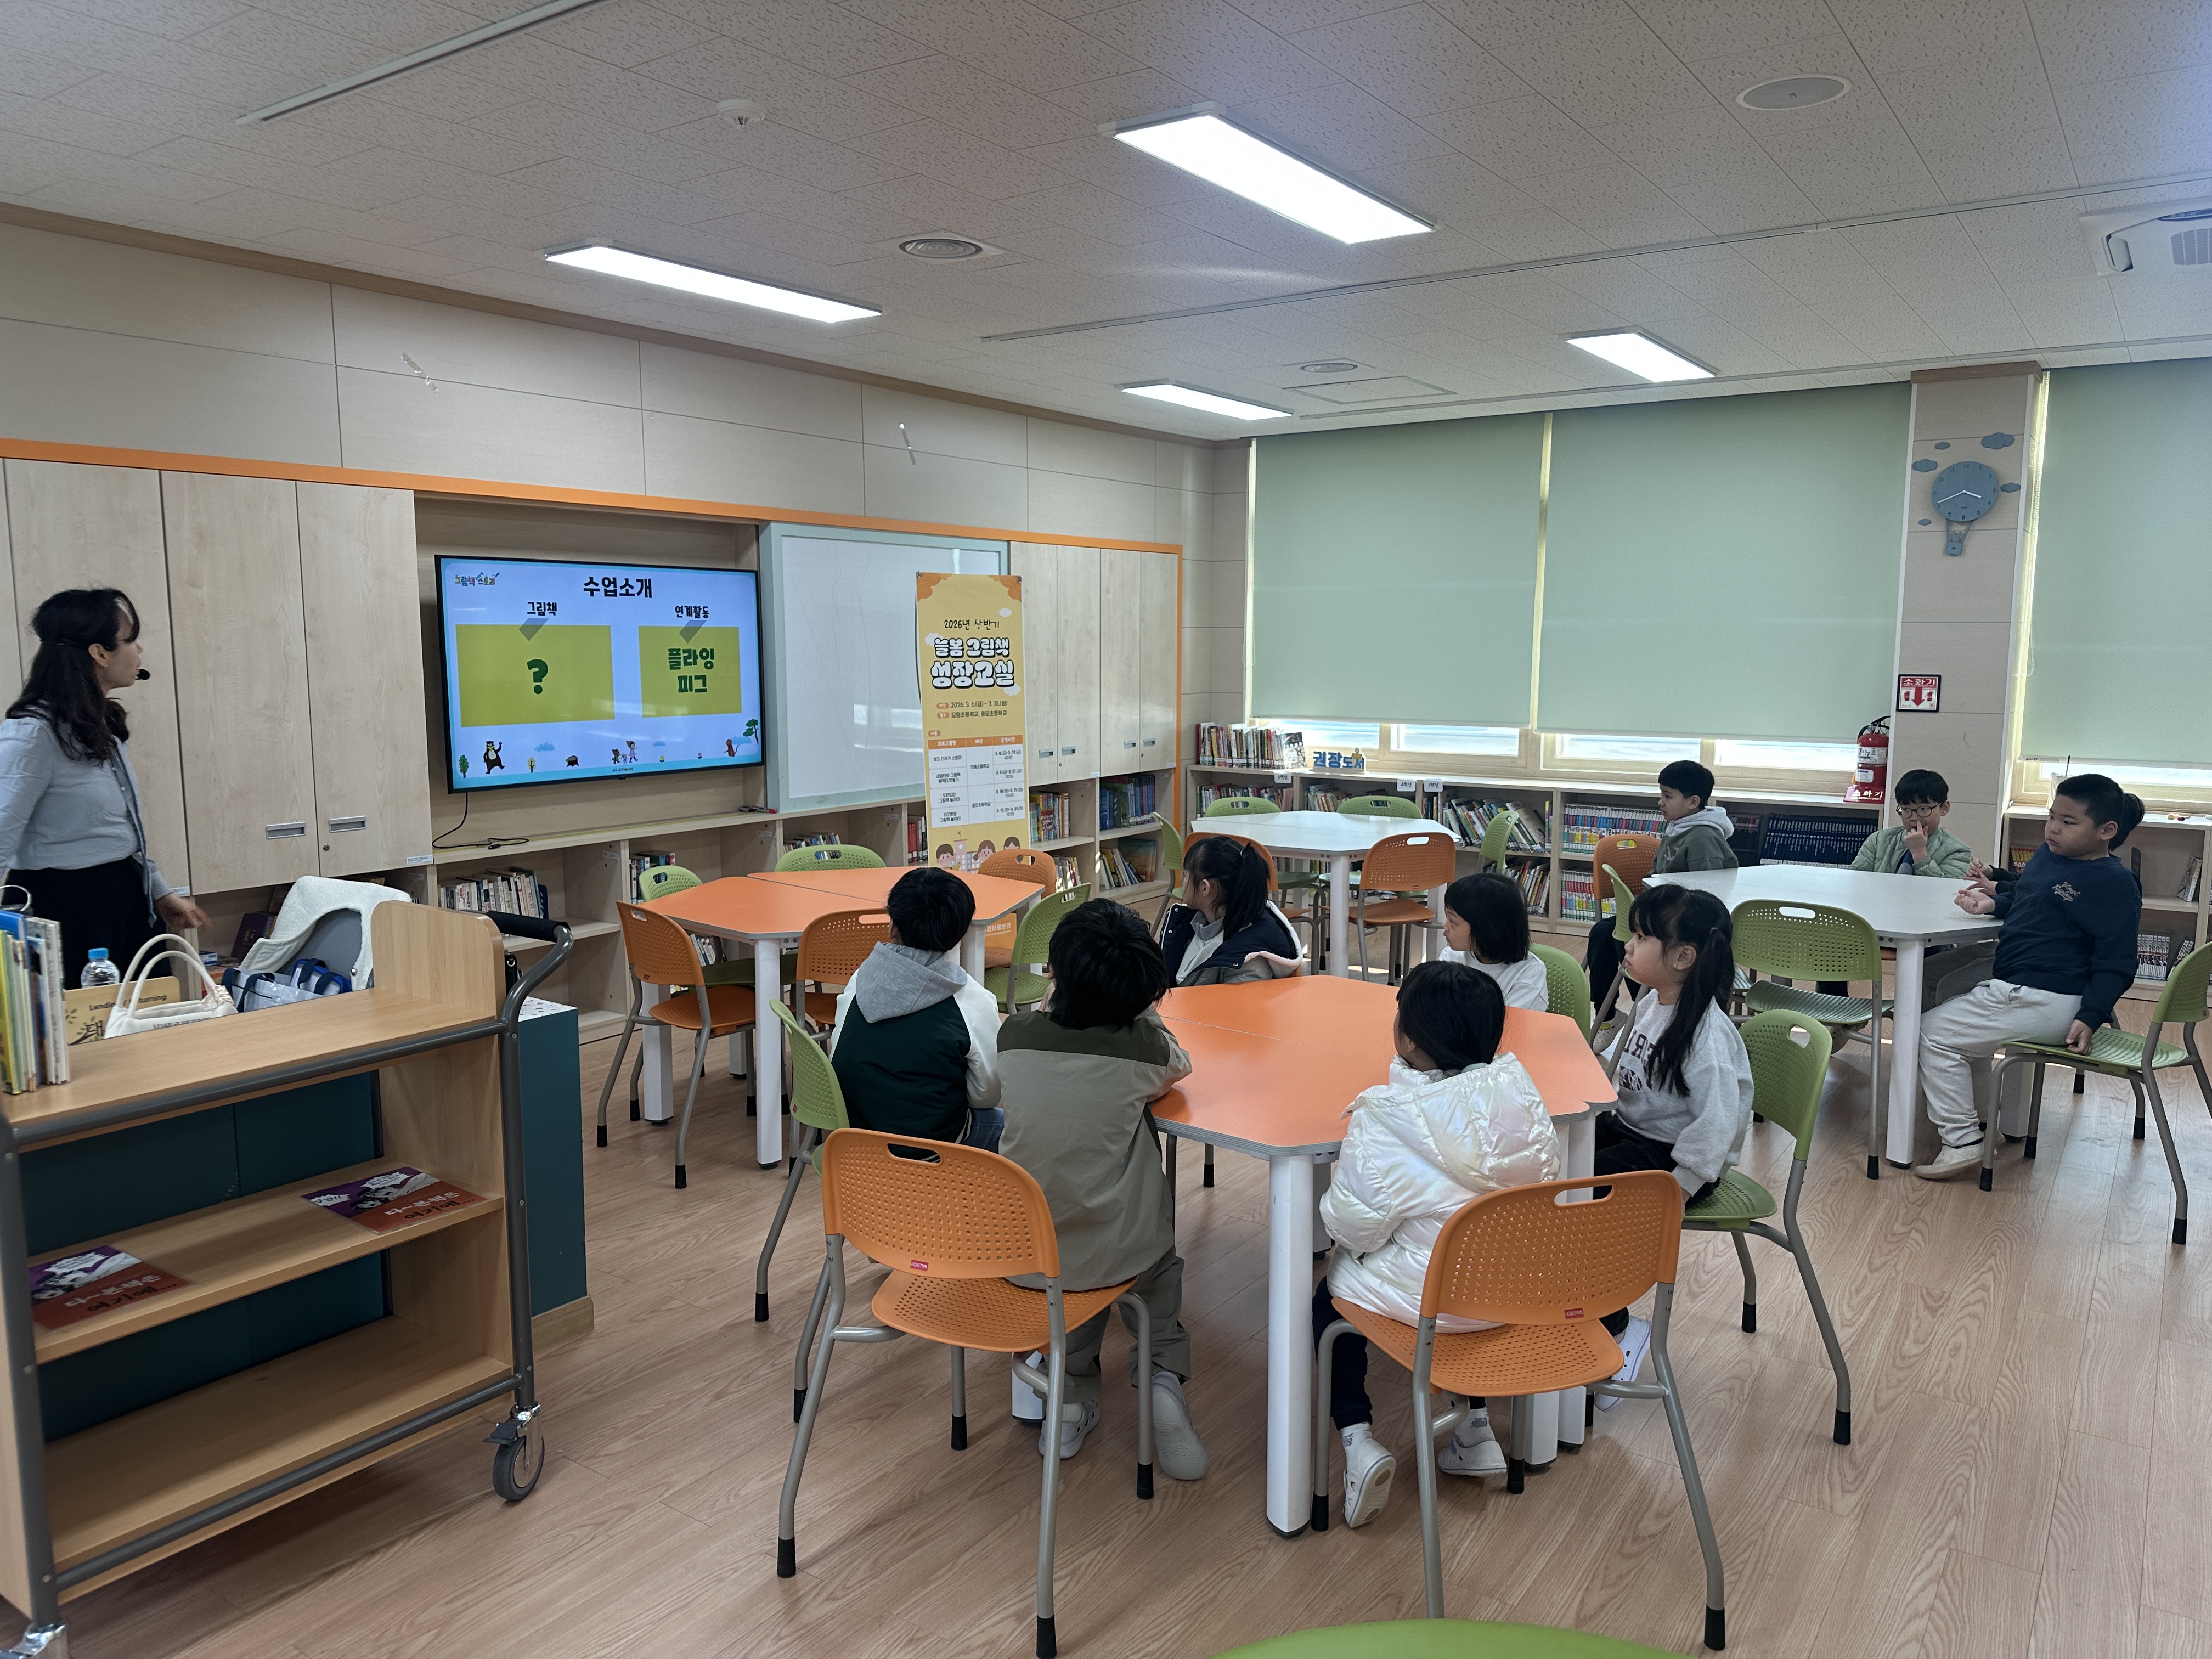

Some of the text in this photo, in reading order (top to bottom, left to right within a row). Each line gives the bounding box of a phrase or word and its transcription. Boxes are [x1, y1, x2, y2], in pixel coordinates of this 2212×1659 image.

[583, 577, 653, 598] 수업소개
[527, 602, 557, 616] 그림책
[675, 605, 709, 618] 연계활동
[944, 619, 1000, 630] 2026년 상반기
[934, 637, 1009, 658] 늘봄 그림책
[668, 648, 714, 670] 플라잉
[527, 659, 548, 695] ?
[931, 659, 1015, 689] 성장교실
[678, 675, 707, 693] 피그
[1313, 751, 1364, 769] 권장도서
[1852, 789, 1883, 798] 소화기
[89, 1002, 116, 1011] Lendin
